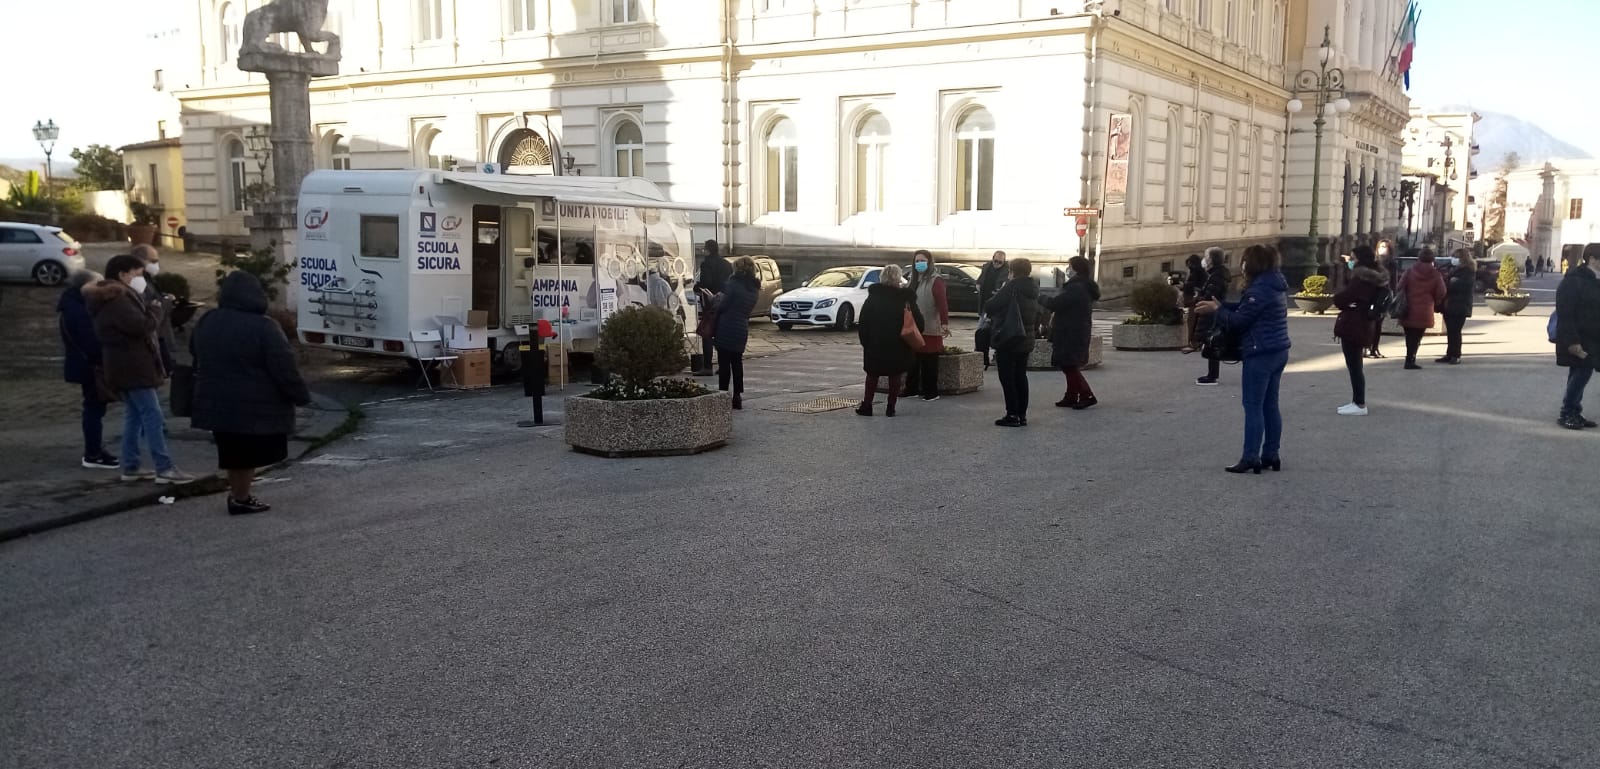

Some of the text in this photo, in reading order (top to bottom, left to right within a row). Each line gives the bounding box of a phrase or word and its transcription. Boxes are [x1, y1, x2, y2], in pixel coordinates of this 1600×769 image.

[417, 241, 459, 254] SCUOLA
[300, 256, 337, 272] SCUOLA
[417, 256, 461, 270] SICURA
[300, 272, 339, 289] SICURA
[533, 279, 578, 292] AMPANIA
